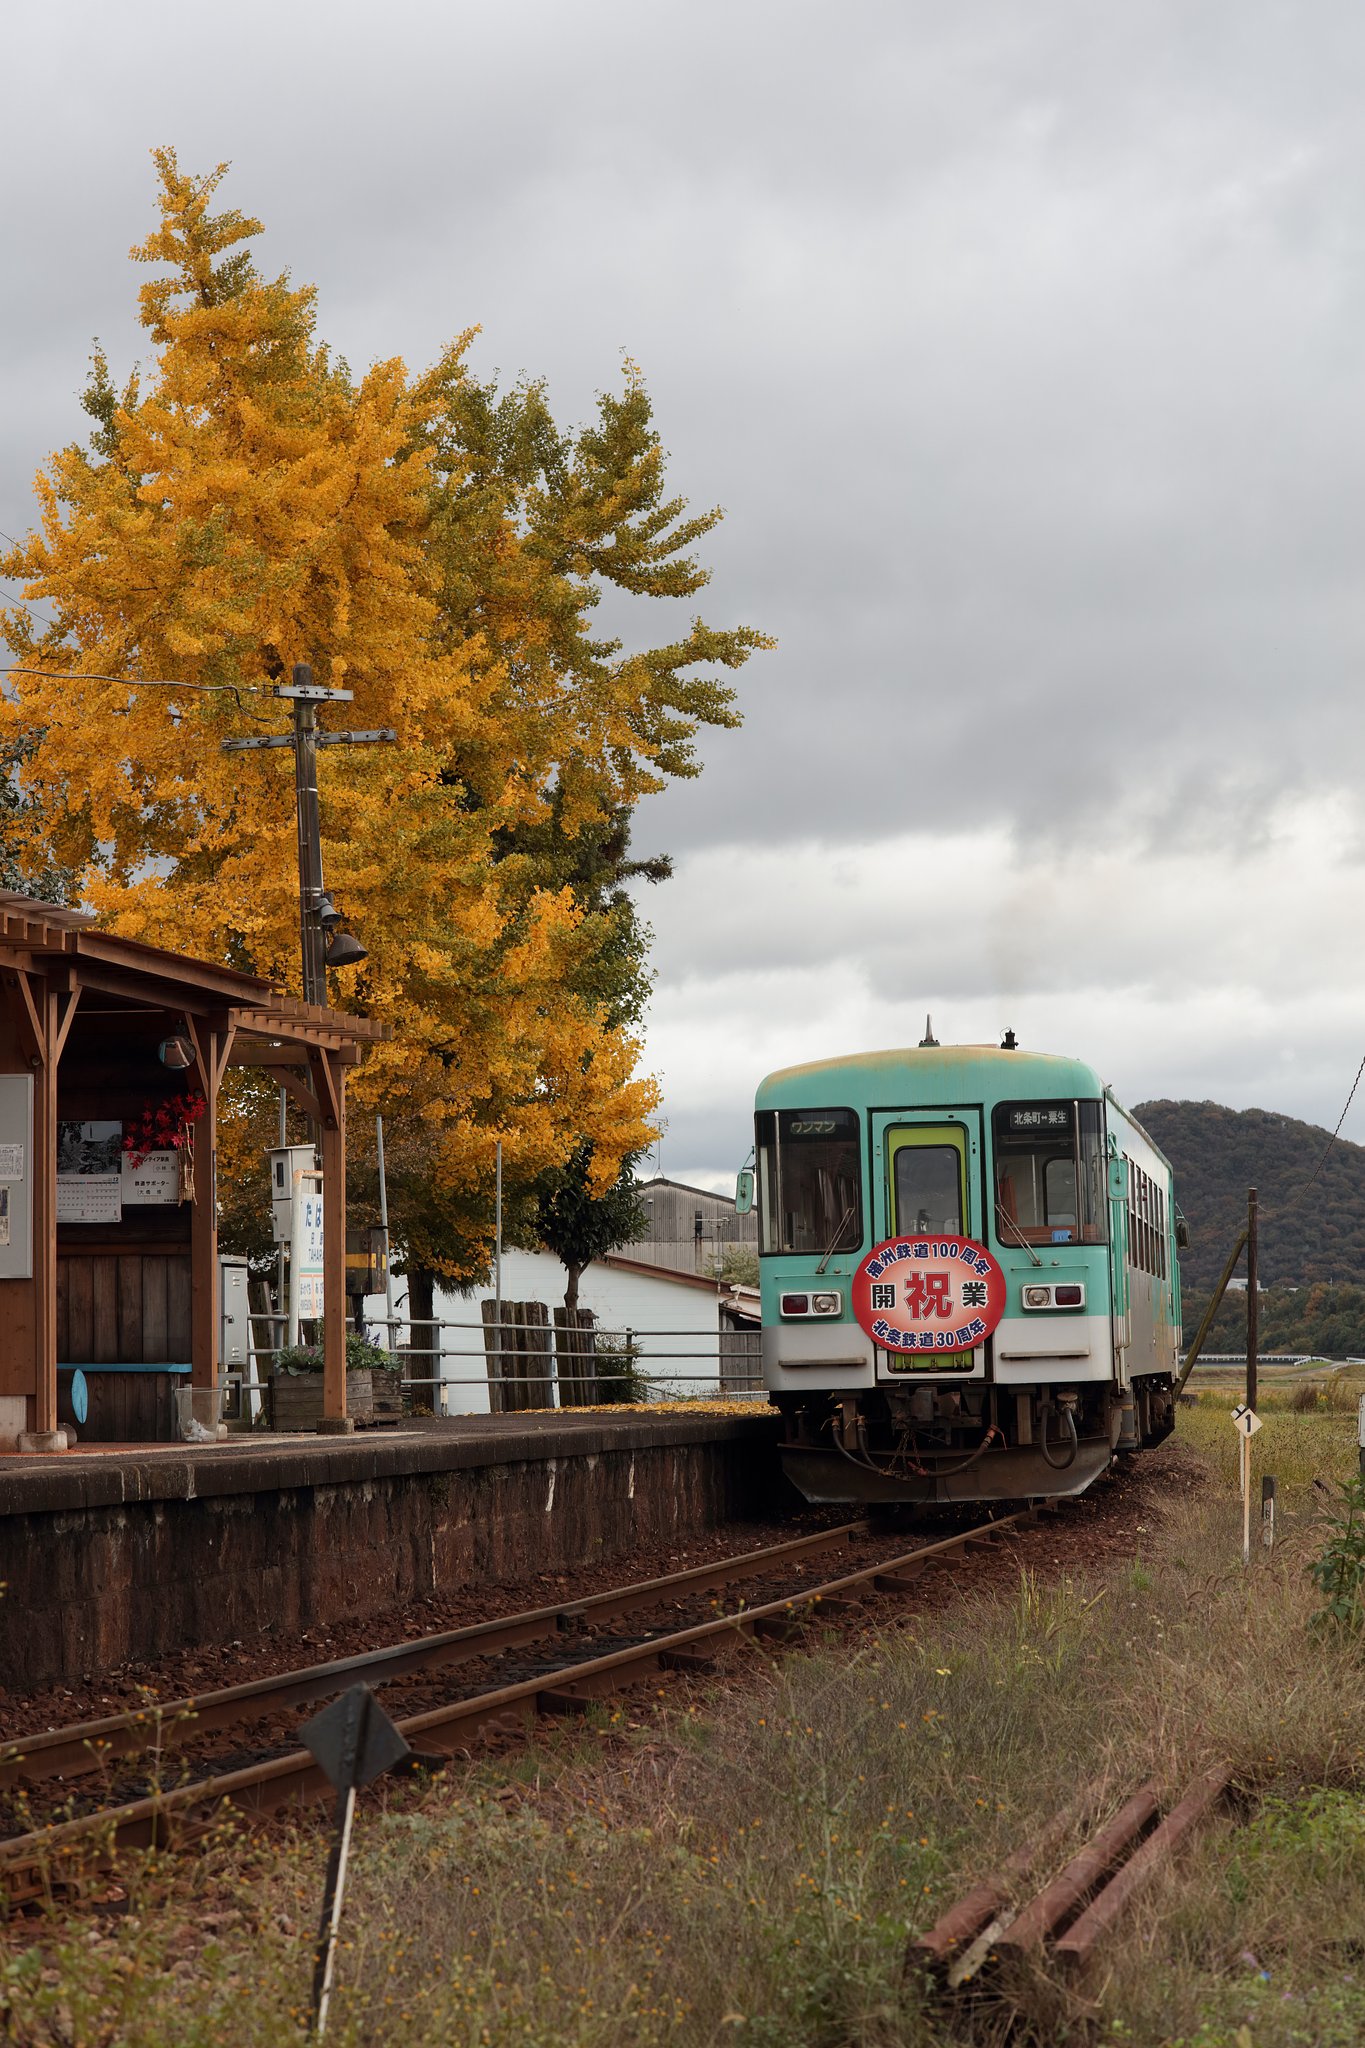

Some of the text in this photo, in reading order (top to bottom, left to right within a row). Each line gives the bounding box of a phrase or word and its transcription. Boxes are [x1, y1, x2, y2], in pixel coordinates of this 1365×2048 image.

[791, 1121, 836, 1133] ワンマン
[871, 1280, 988, 1310] 開 業
[904, 1270, 955, 1321] 祝
[872, 1318, 987, 1348] 北条鉄道30周年
[1245, 1413, 1252, 1433] 1
